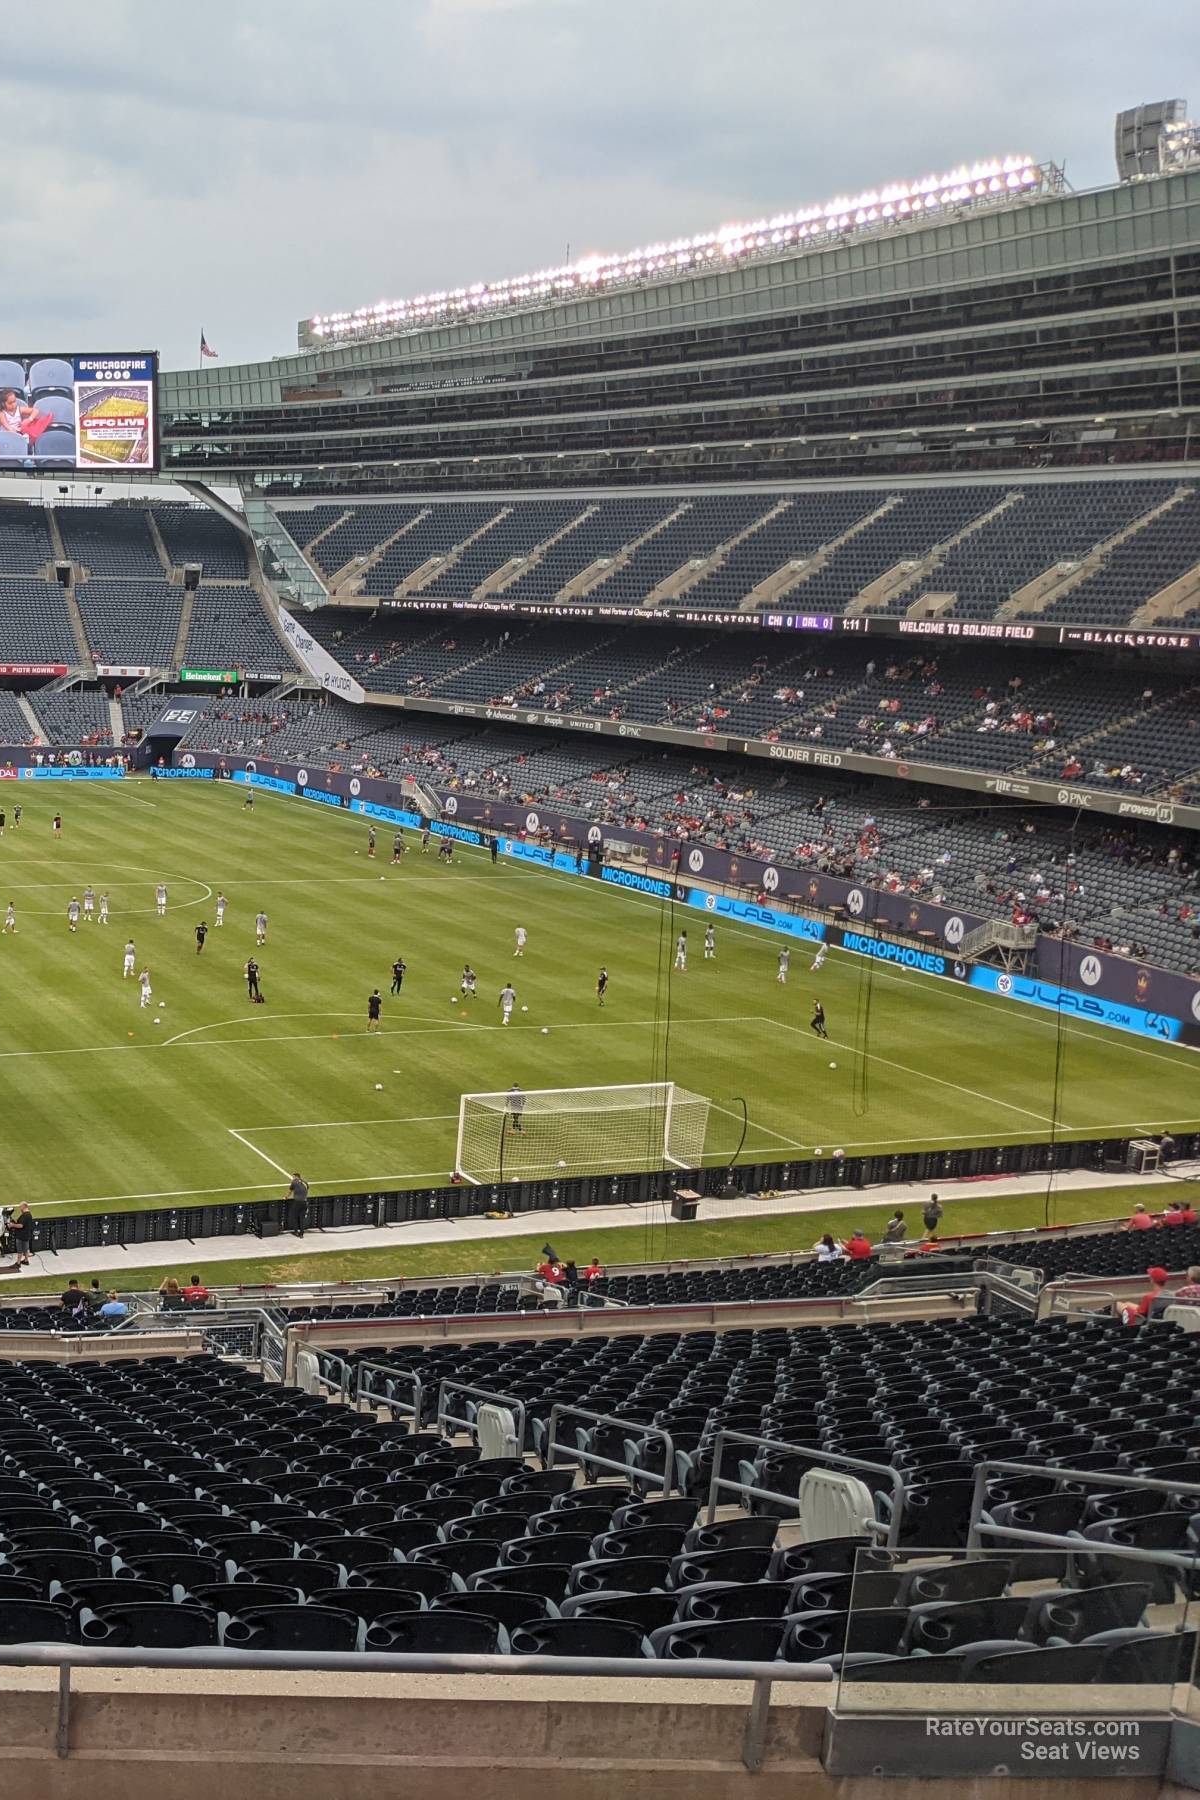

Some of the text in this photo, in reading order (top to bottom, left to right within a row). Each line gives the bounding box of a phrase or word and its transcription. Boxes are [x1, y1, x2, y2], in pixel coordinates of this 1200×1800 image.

[79, 360, 146, 370] @CHICAGOFIRE
[391, 601, 448, 610] BLACKSTONE
[530, 606, 594, 616] BLACKSTONE
[634, 608, 653, 618] Chicago
[687, 614, 760, 624] BLACKSTONE
[768, 616, 859, 630] CHI 0 ORL 0 1:11
[899, 622, 1034, 639] WELCOME TO SOLDIER FIELD
[1084, 632, 1189, 647] BLACKSTONE
[186, 672, 221, 680] Heineken
[330, 676, 352, 692] HYUNDAI
[492, 708, 517, 721] Advocate
[570, 720, 593, 729] UNITED
[627, 726, 641, 736] PNC
[770, 746, 841, 766] SOLDIER FIELD
[150, 766, 214, 777] CROPHONES
[251, 776, 278, 788] JLAB
[303, 788, 341, 805] MICROPHONES
[1070, 792, 1092, 806] PNC
[365, 806, 396, 820] JLAB
[1119, 802, 1156, 817] proven
[431, 821, 480, 845] MICROPHONES
[602, 867, 671, 897] MICROPHONES
[717, 902, 793, 930] JLAB .COM
[843, 932, 945, 974] MICROPHONES
[1014, 985, 1130, 1026] JLAB .COM
[552, 1267, 559, 1276] 9
